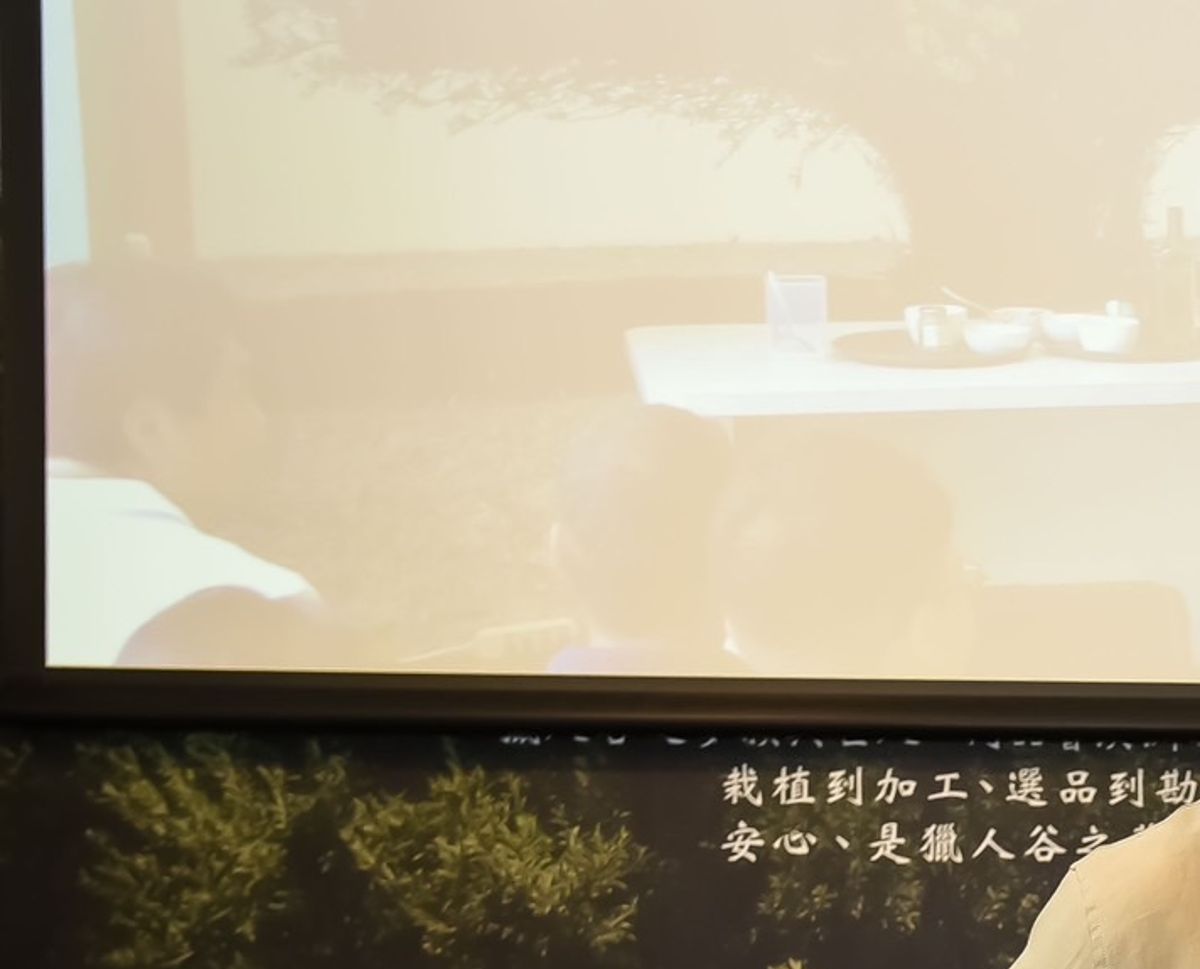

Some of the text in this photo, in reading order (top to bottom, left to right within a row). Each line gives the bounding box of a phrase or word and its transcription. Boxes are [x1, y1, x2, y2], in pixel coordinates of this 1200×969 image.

[721, 820, 1156, 865] 安心、是獵人谷之
